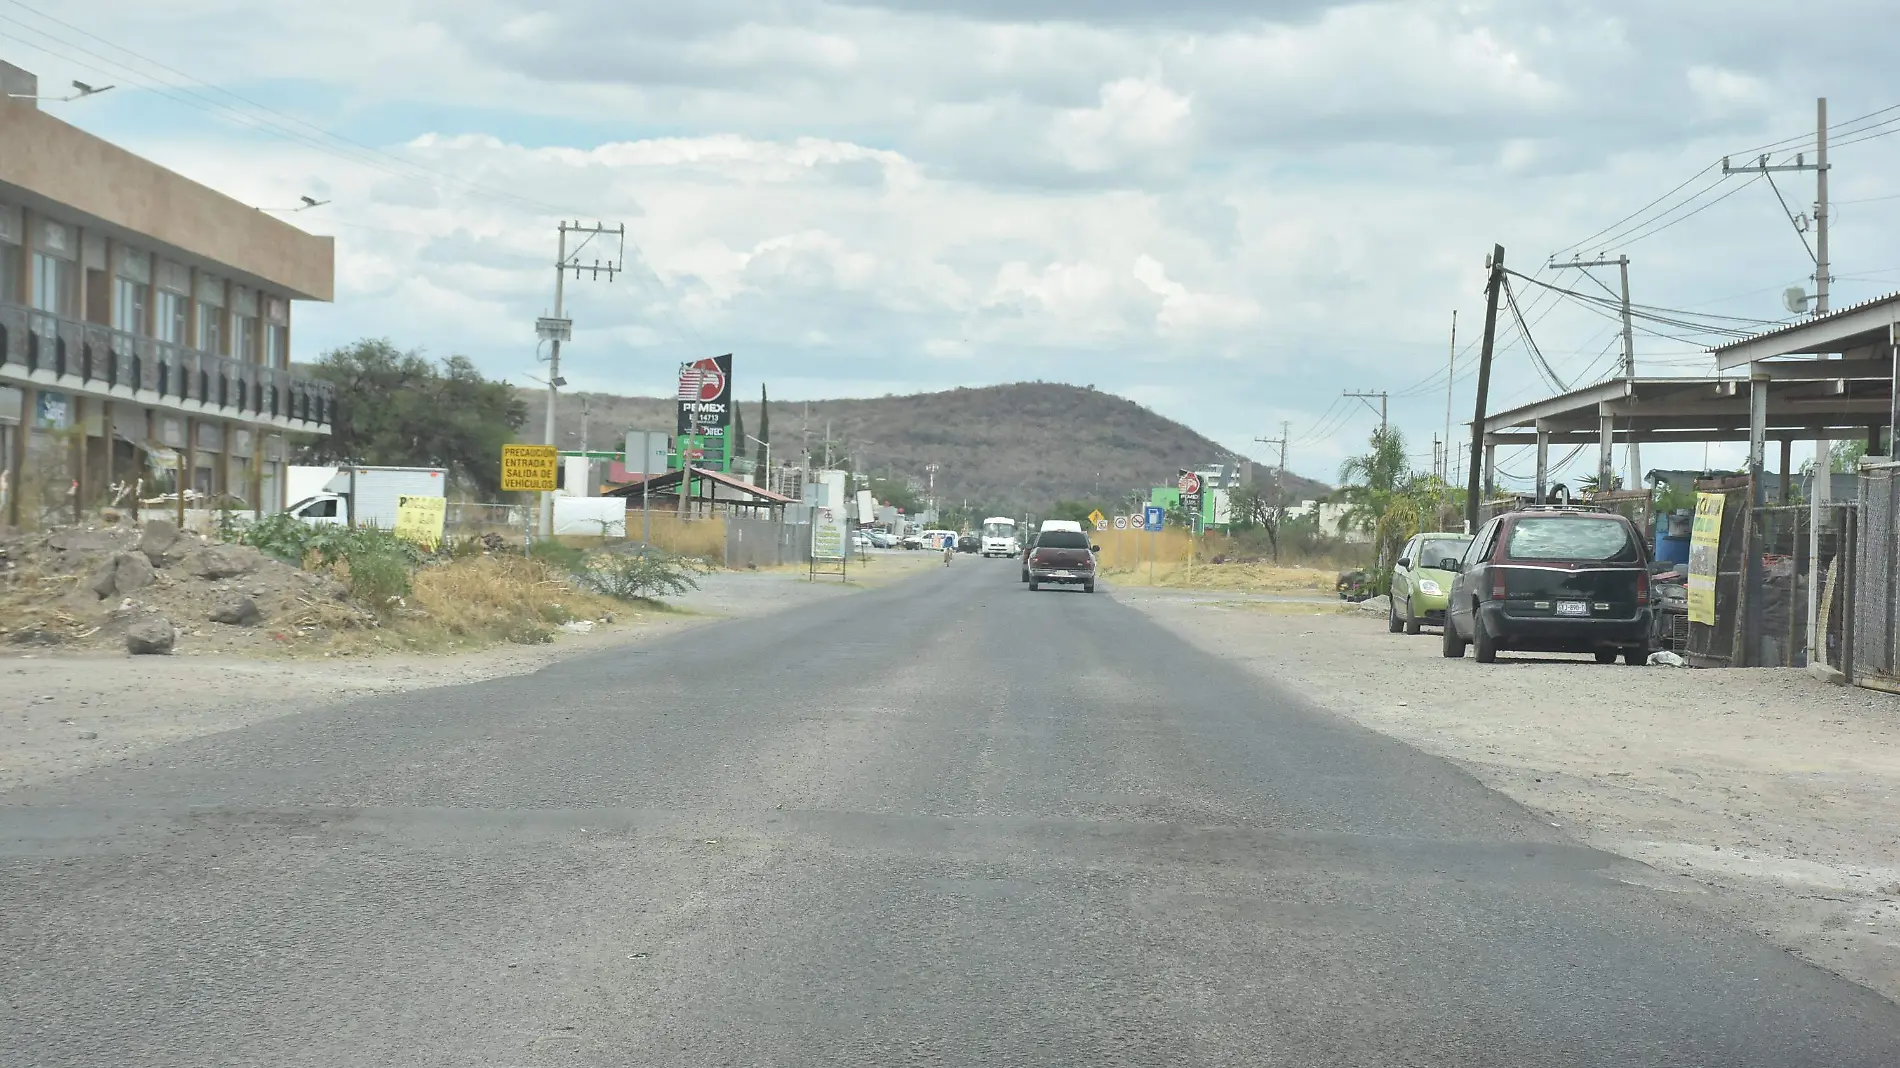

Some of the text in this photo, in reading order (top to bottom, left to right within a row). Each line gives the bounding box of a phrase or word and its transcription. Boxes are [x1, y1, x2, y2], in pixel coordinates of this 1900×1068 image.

[683, 403, 725, 412] PEMEX
[505, 458, 545, 467] ENTRADA
[506, 469, 553, 478] SALIDA DE
